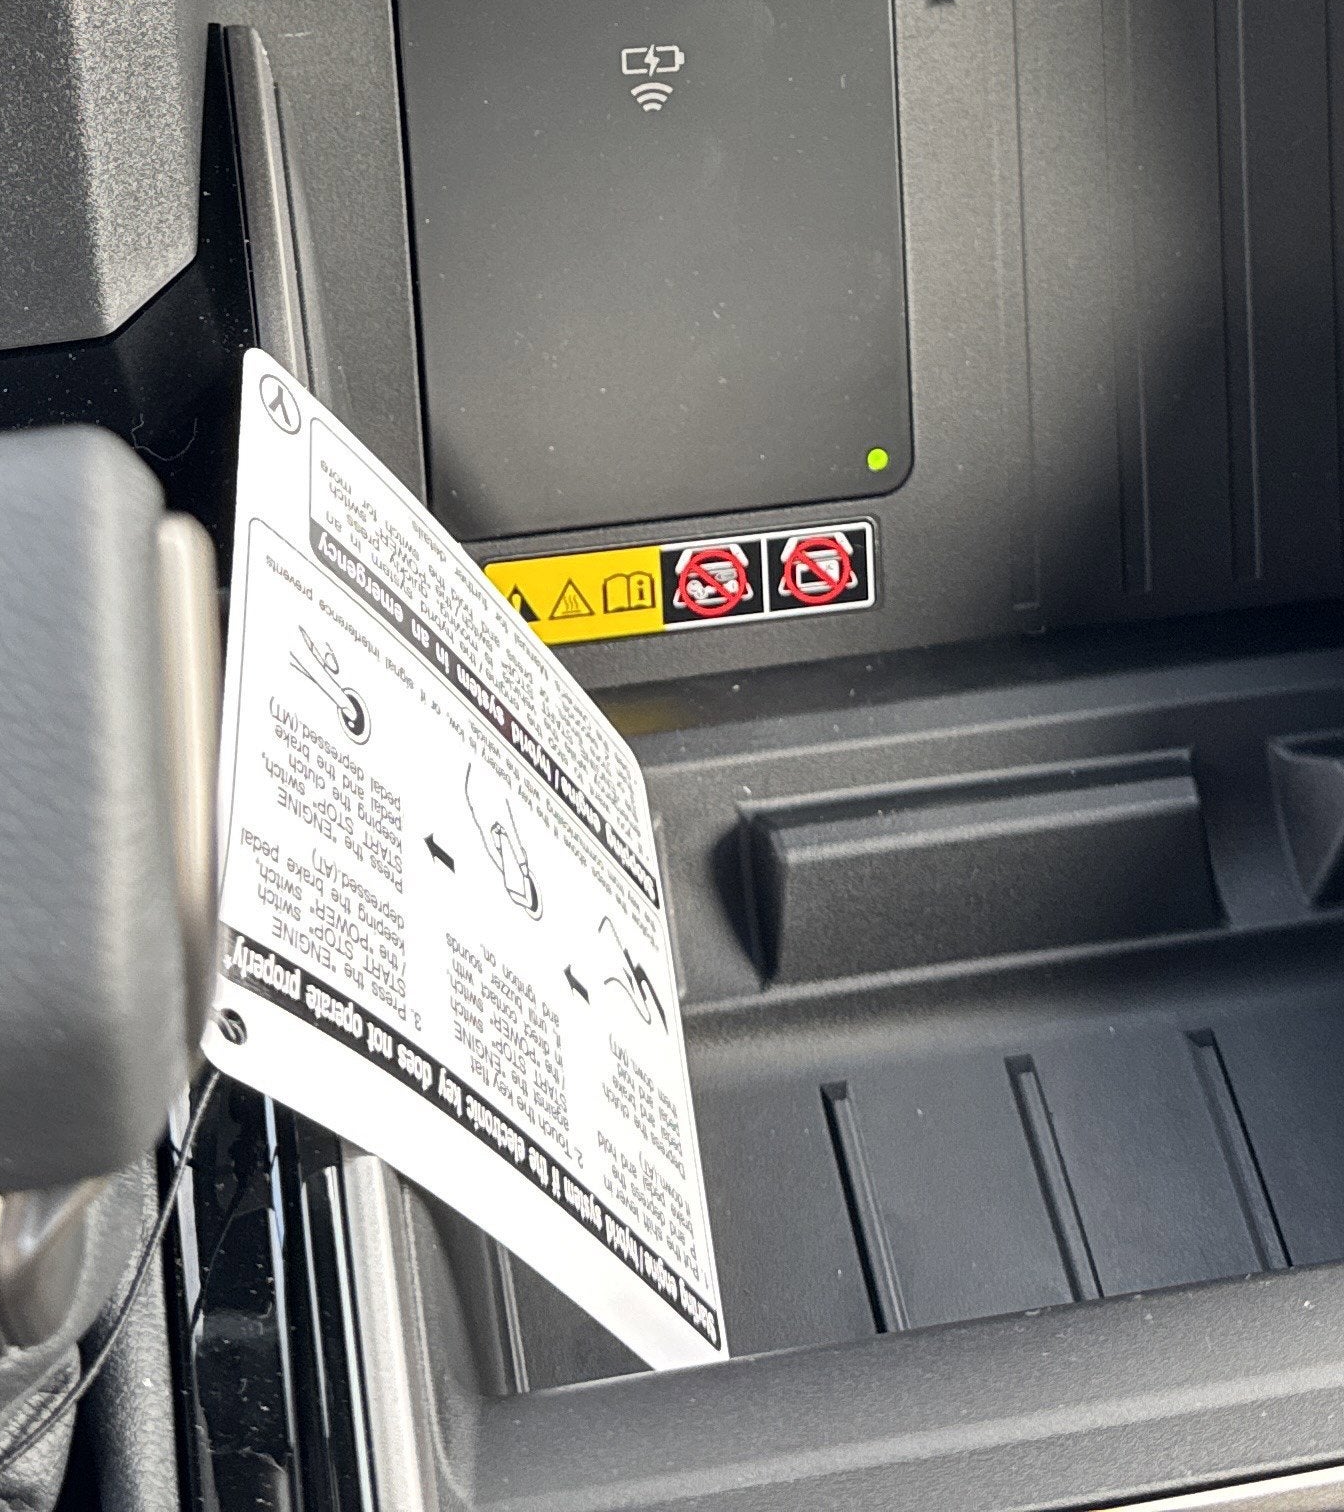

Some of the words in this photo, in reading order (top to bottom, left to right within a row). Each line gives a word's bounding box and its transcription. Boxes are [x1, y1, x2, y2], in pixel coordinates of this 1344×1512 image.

[318, 528, 403, 623] emergency
[411, 617, 429, 649] an
[435, 640, 449, 675] in
[456, 662, 504, 727] system
[275, 723, 309, 761] brake
[288, 753, 324, 791] clutch
[316, 754, 334, 781] the
[342, 773, 363, 802] and
[332, 785, 350, 813] the
[370, 776, 400, 813] pedal
[371, 796, 401, 832] pedal
[240, 826, 278, 863] pedal
[357, 801, 401, 853] keeping
[344, 834, 362, 862] the
[362, 829, 402, 874] START
[604, 819, 655, 901] Stopping
[287, 856, 323, 897] brake
[370, 854, 402, 894] Press
[257, 882, 300, 923] switch
[331, 886, 350, 915] the
[358, 901, 404, 956] keeping
[344, 961, 363, 990] the
[363, 952, 405, 998] START
[379, 943, 397, 971] the
[305, 980, 362, 1041] operate
[371, 980, 406, 1021] Press
[366, 1020, 392, 1062] not
[397, 1042, 432, 1093] does
[437, 1064, 462, 1118] key
[466, 1093, 525, 1165] electronic
[528, 1144, 548, 1187] the
[550, 1163, 561, 1199] if
[563, 1174, 602, 1232] system
[678, 1275, 716, 1343] Starting
